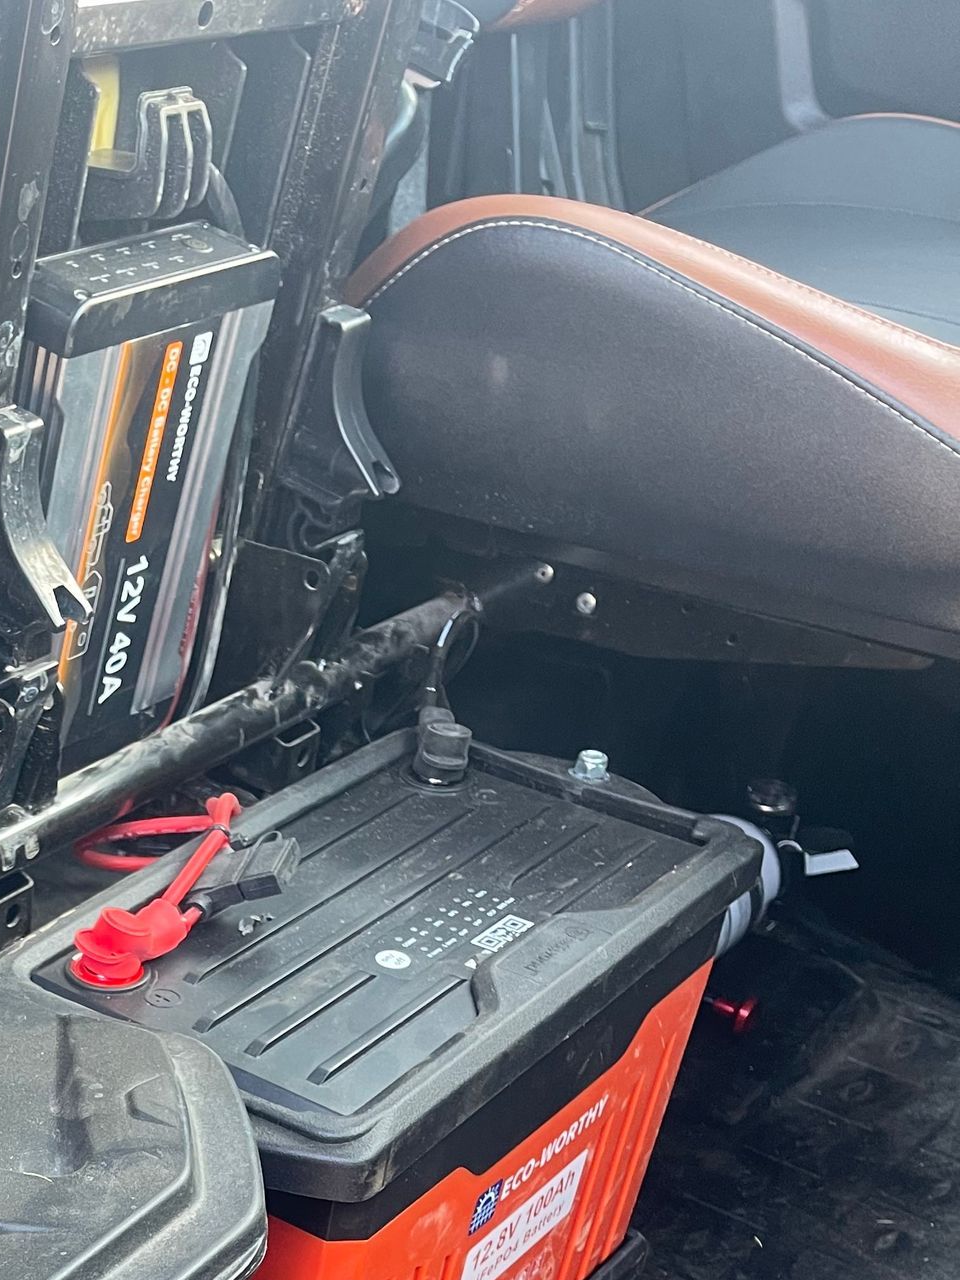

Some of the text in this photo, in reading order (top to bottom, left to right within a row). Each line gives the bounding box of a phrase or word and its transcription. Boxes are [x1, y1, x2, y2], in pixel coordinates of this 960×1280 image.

[166, 347, 180, 373] DC
[158, 387, 171, 412] DC
[166, 363, 202, 482] ECO-WORTHY
[142, 415, 166, 472] Battery
[129, 476, 152, 536] Charger
[98, 555, 149, 704] 12V 40A
[500, 1093, 609, 1202] ECO-WORTHY
[472, 1169, 576, 1271] 12.8V 100Ah
[523, 1201, 565, 1244] Battery
